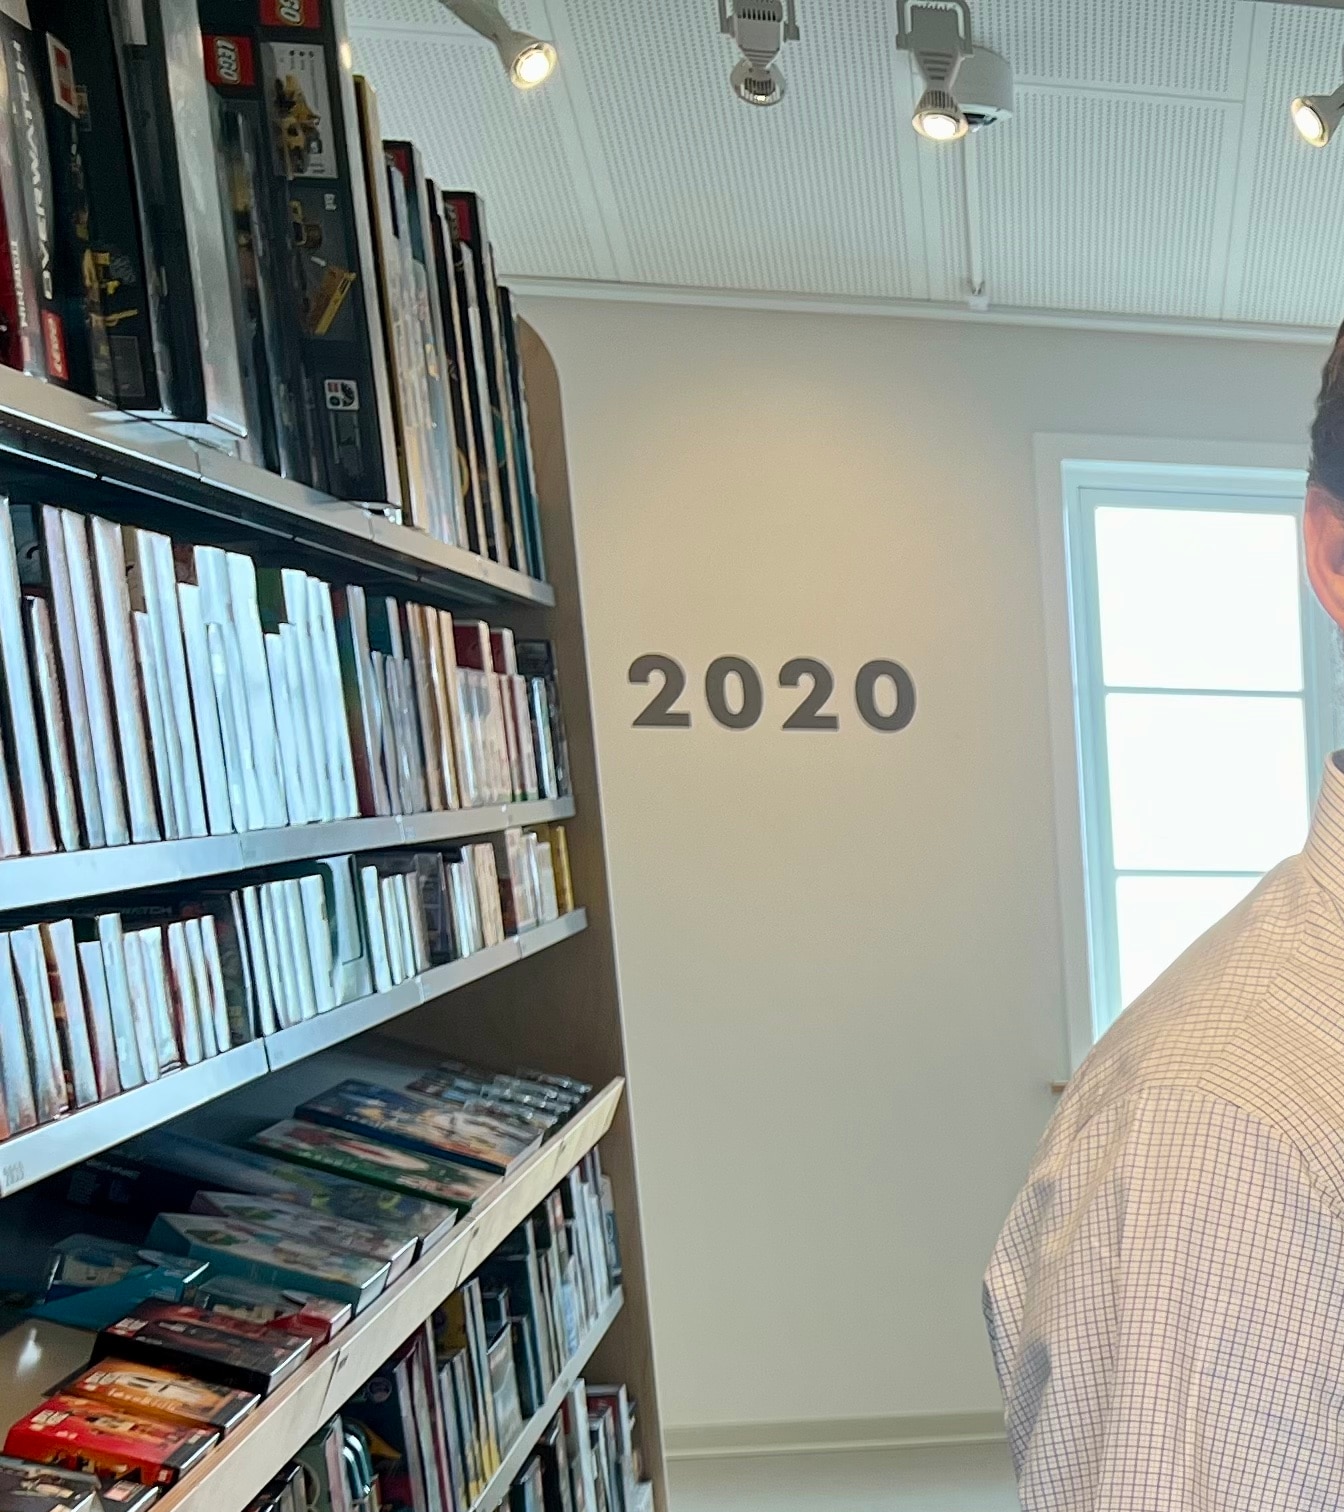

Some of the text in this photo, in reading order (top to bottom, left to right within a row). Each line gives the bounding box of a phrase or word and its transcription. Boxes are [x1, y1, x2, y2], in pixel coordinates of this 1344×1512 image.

[218, 38, 236, 83] LEGO
[12, 39, 53, 300] OVERWATCH
[47, 316, 64, 375] LEGO
[628, 654, 916, 731] 2020
